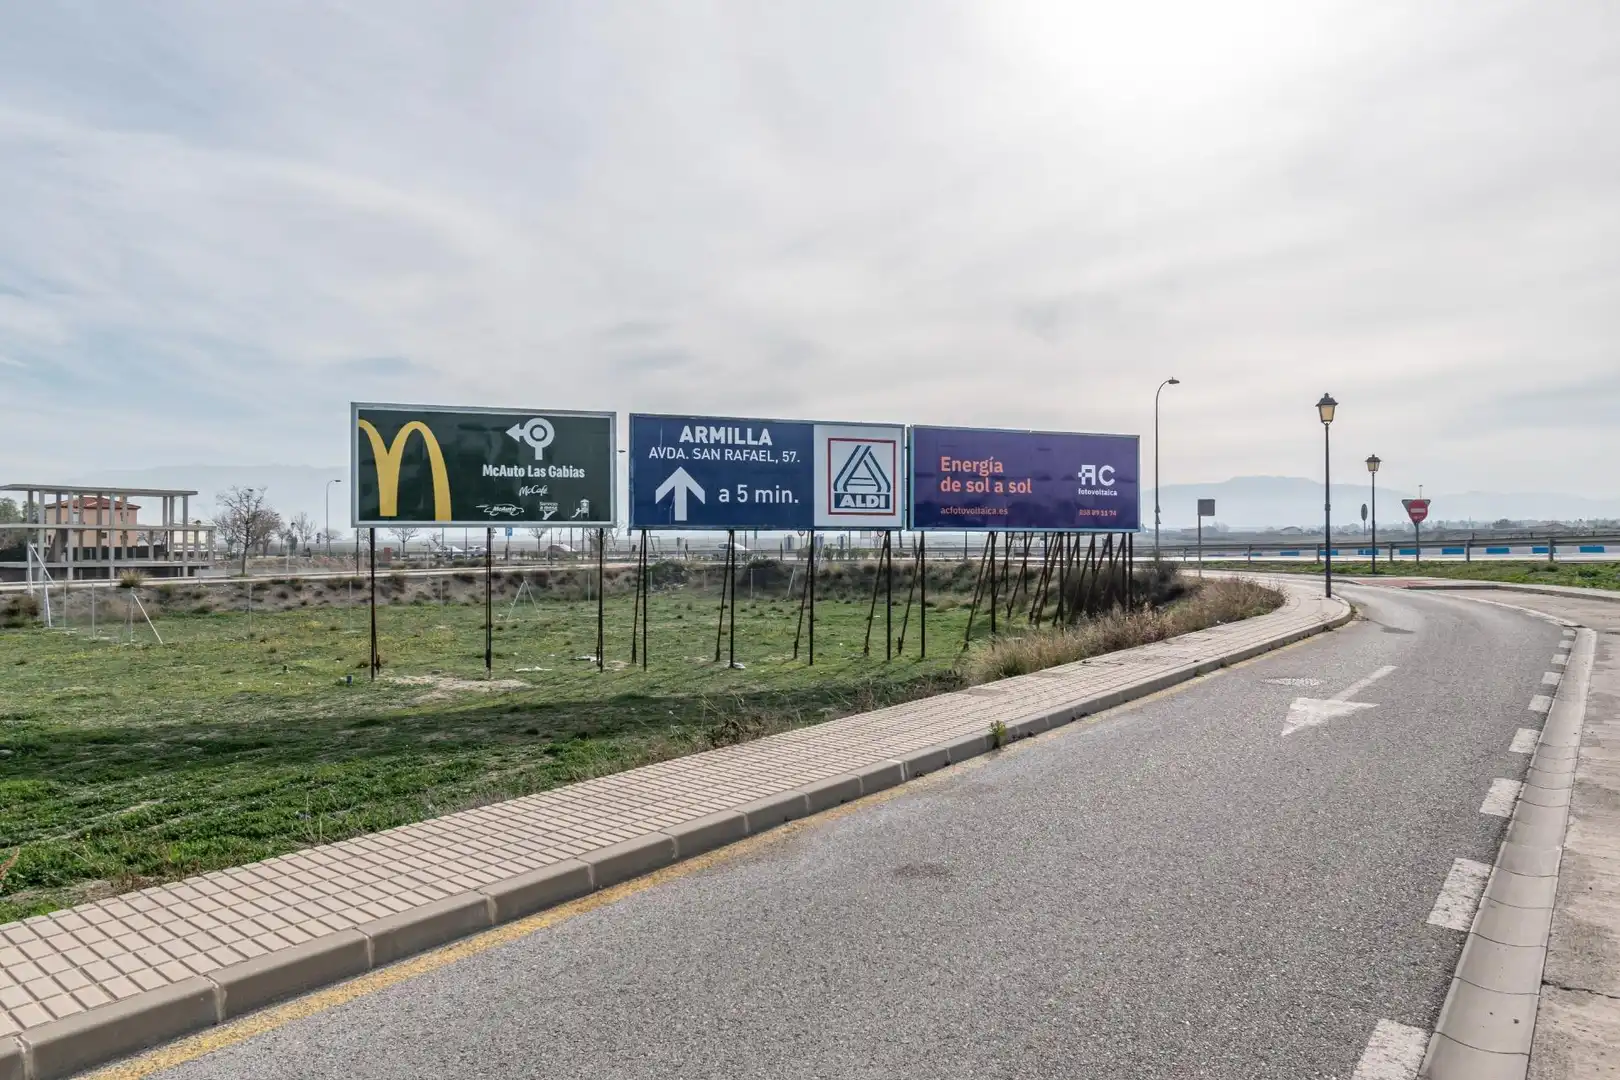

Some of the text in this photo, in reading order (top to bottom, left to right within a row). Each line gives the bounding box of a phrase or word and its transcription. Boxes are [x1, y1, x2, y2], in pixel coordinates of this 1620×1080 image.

[679, 425, 773, 445] ARMILLA
[649, 447, 800, 463] AVDA. SAN RAFAEL, 57.
[482, 464, 585, 478] McAuto Las Gabias
[940, 456, 1003, 476] Energía
[940, 477, 1032, 494] de sol a sol
[1078, 488, 1117, 496] fotovoltaica
[718, 485, 799, 503] a 5 min.
[840, 495, 886, 508] ALDI
[940, 506, 1008, 514] acfotovoltaica.es
